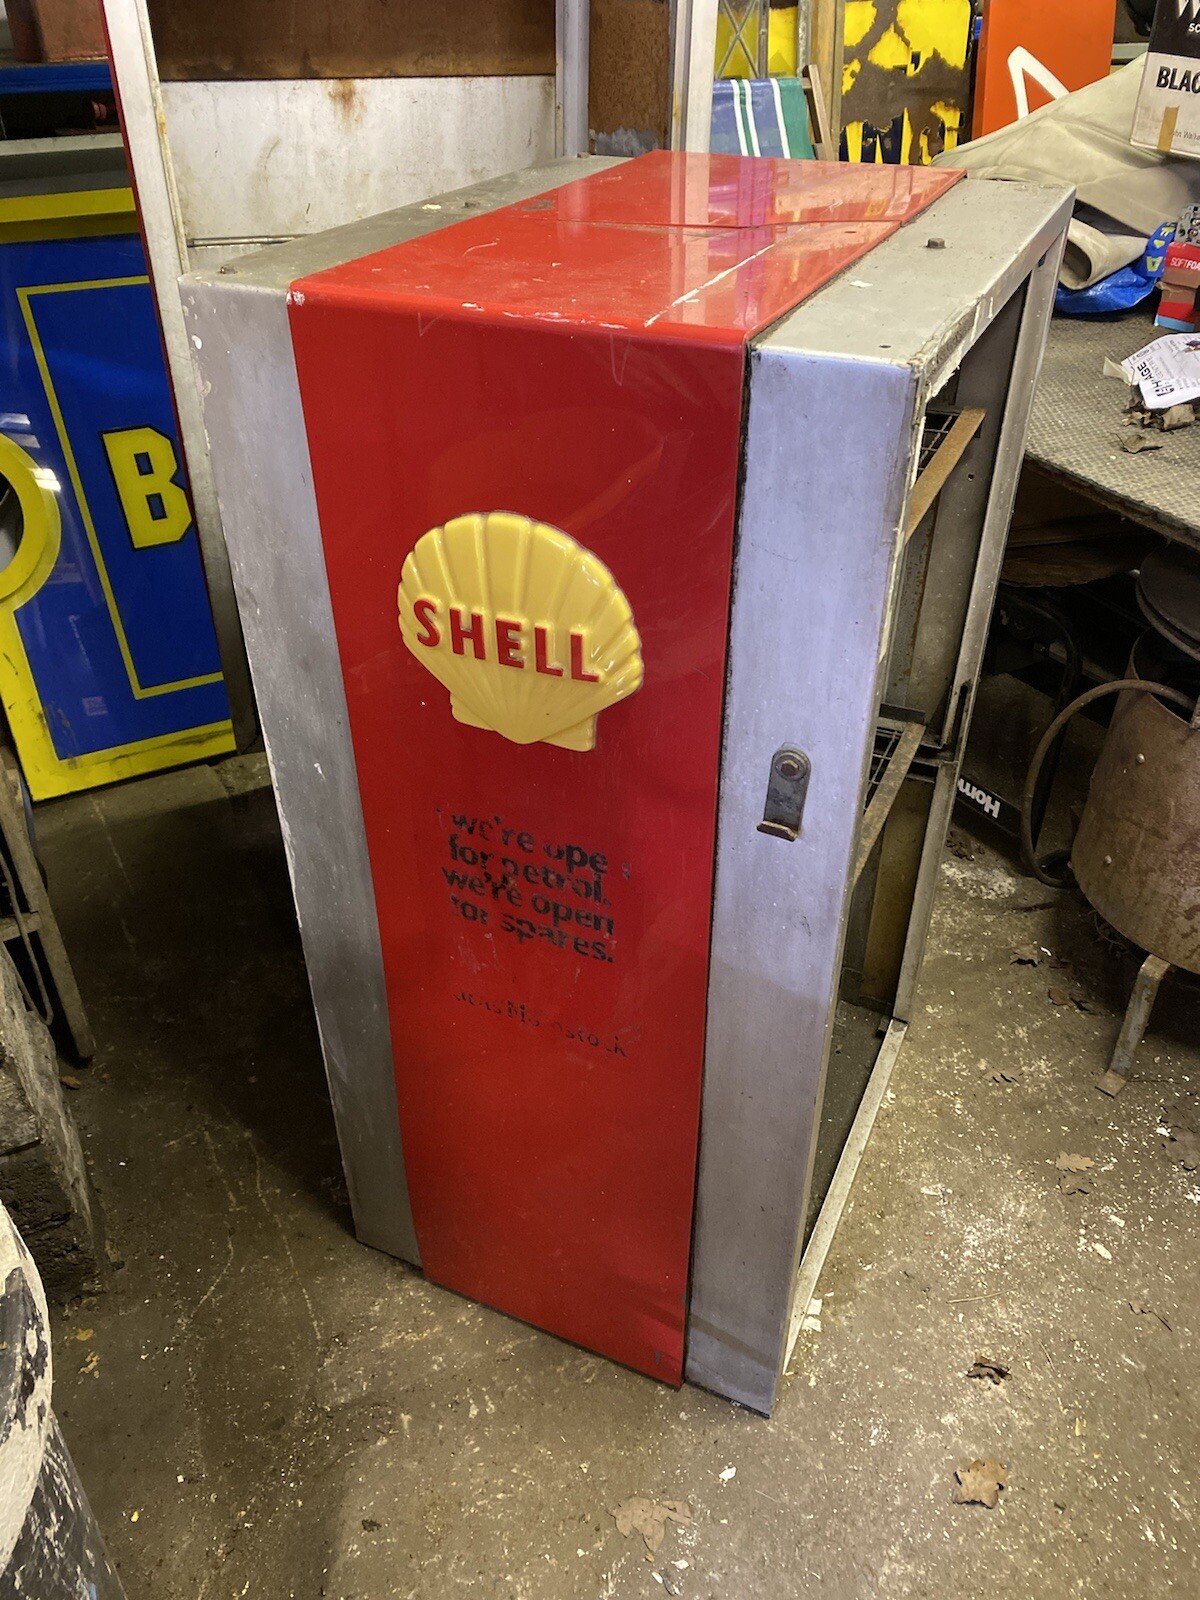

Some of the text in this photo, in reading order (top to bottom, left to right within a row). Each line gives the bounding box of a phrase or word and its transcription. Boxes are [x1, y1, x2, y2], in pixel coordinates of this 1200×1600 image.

[100, 426, 193, 550] B
[413, 598, 600, 683] SHELL
[957, 778, 1000, 819] Hom
[450, 813, 535, 853] we're
[441, 866, 615, 936] we're open
[501, 912, 615, 964] spares.
